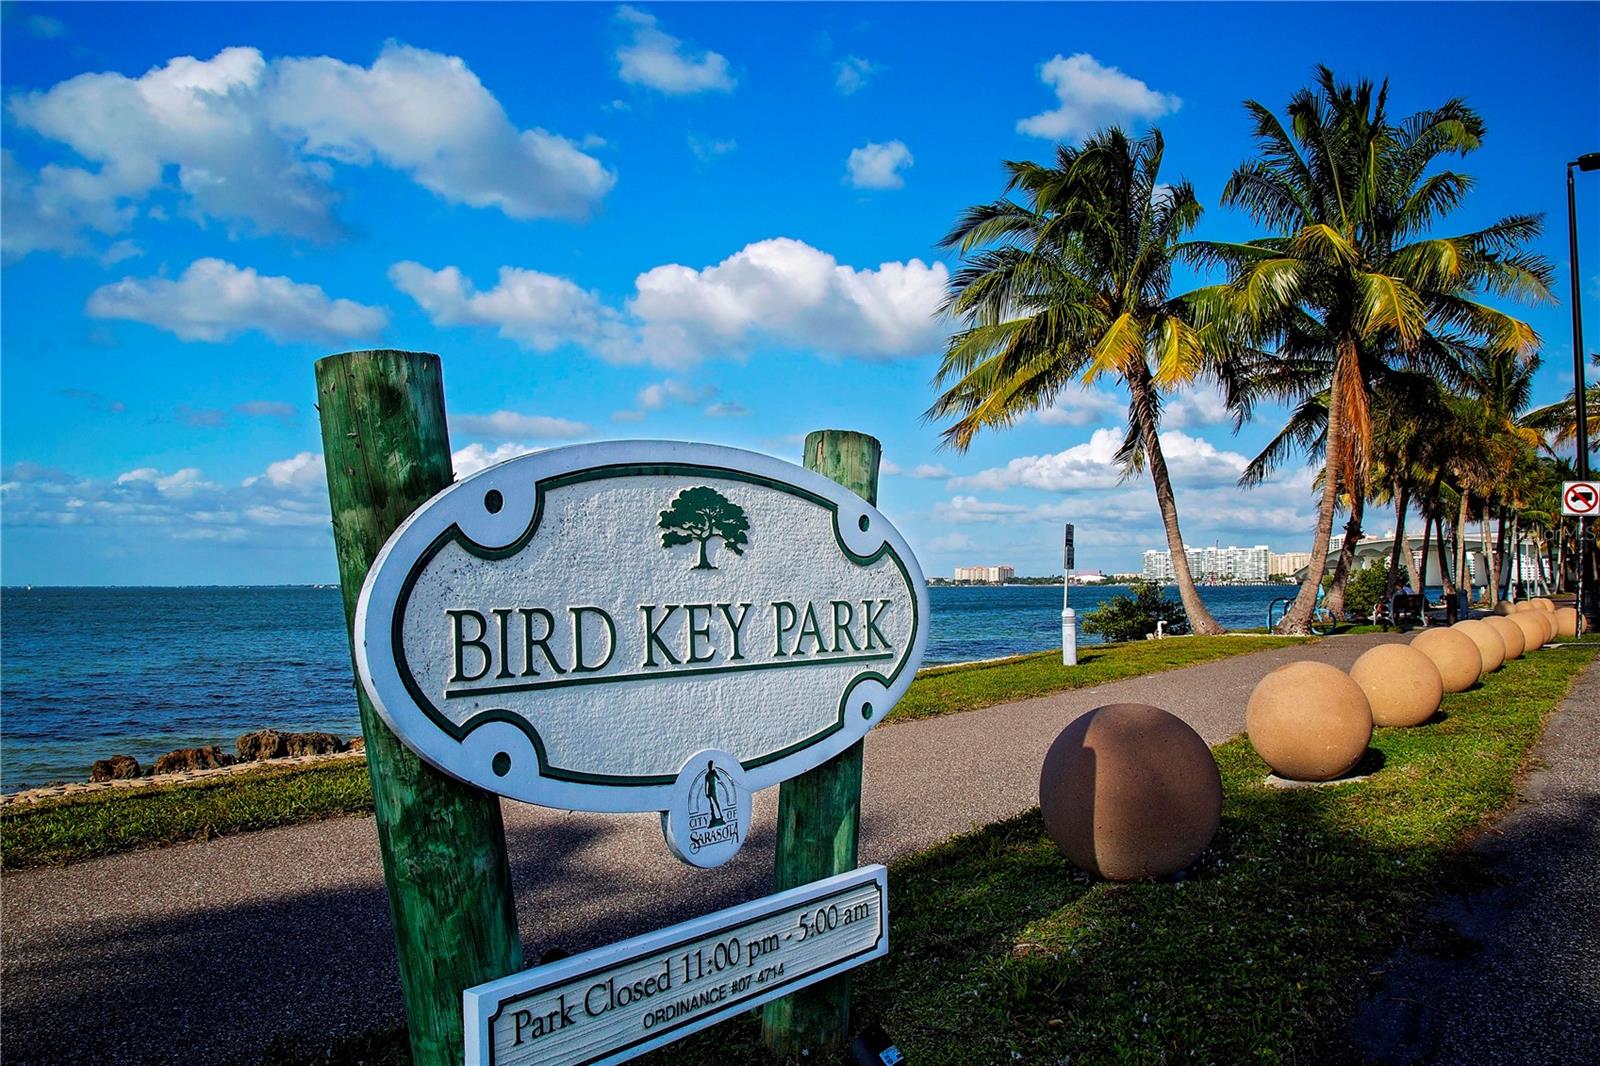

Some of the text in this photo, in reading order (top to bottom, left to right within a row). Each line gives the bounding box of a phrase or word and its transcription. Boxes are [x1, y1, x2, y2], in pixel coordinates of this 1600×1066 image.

[446, 599, 892, 683] BIRD KEY PARK
[689, 809, 737, 828] CITY OF
[511, 994, 577, 1046] Park
[584, 958, 673, 1017] Closed
[681, 937, 741, 984] 11:00
[745, 932, 780, 967] pm
[798, 904, 838, 942] 5:00
[843, 902, 869, 925] am
[643, 962, 785, 1029] ORDINANCE #07 4714
